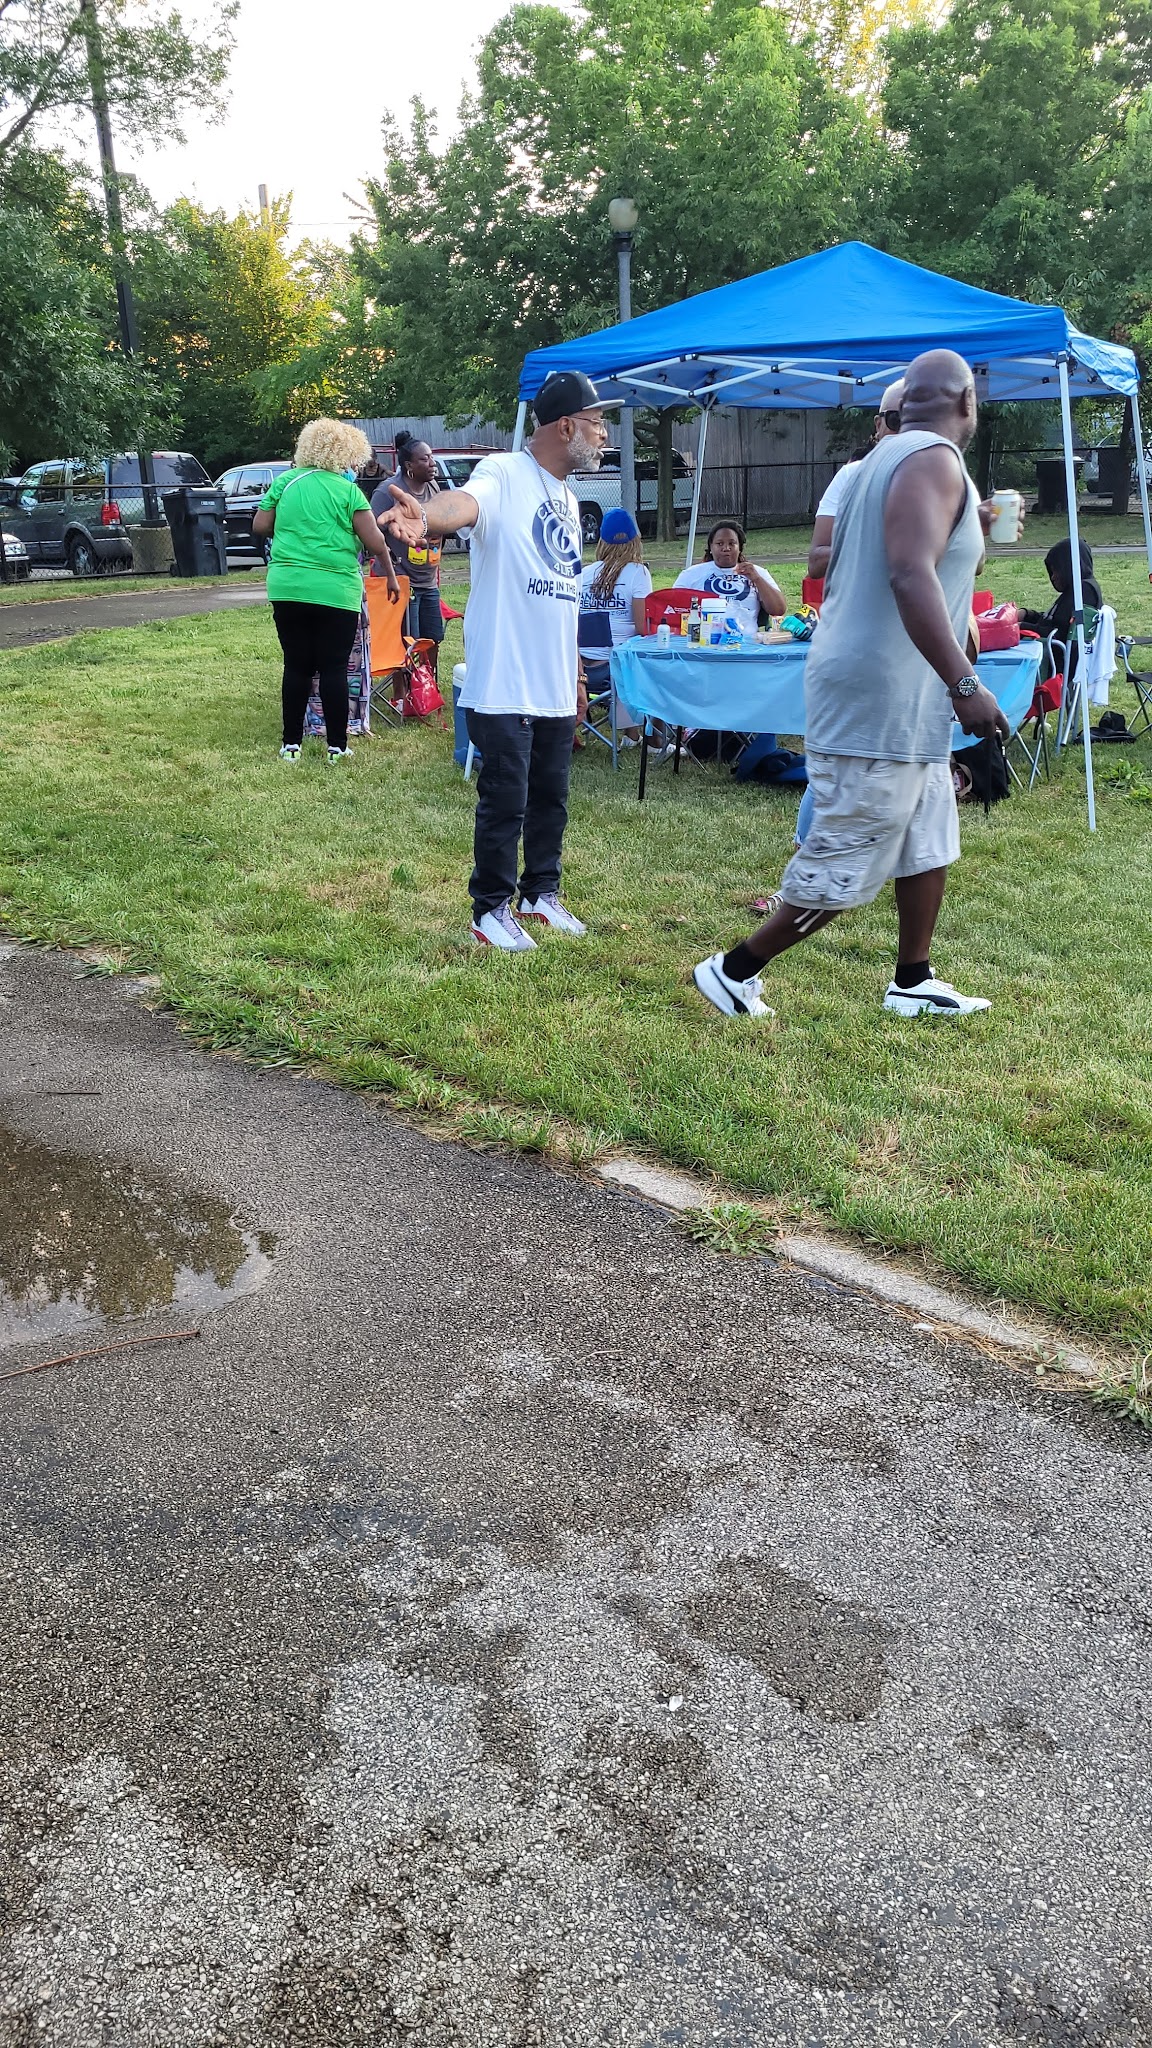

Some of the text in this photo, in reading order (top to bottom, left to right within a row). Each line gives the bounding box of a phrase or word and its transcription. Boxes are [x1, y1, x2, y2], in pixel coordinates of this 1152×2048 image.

[527, 578, 576, 597] HOPE IN THE
